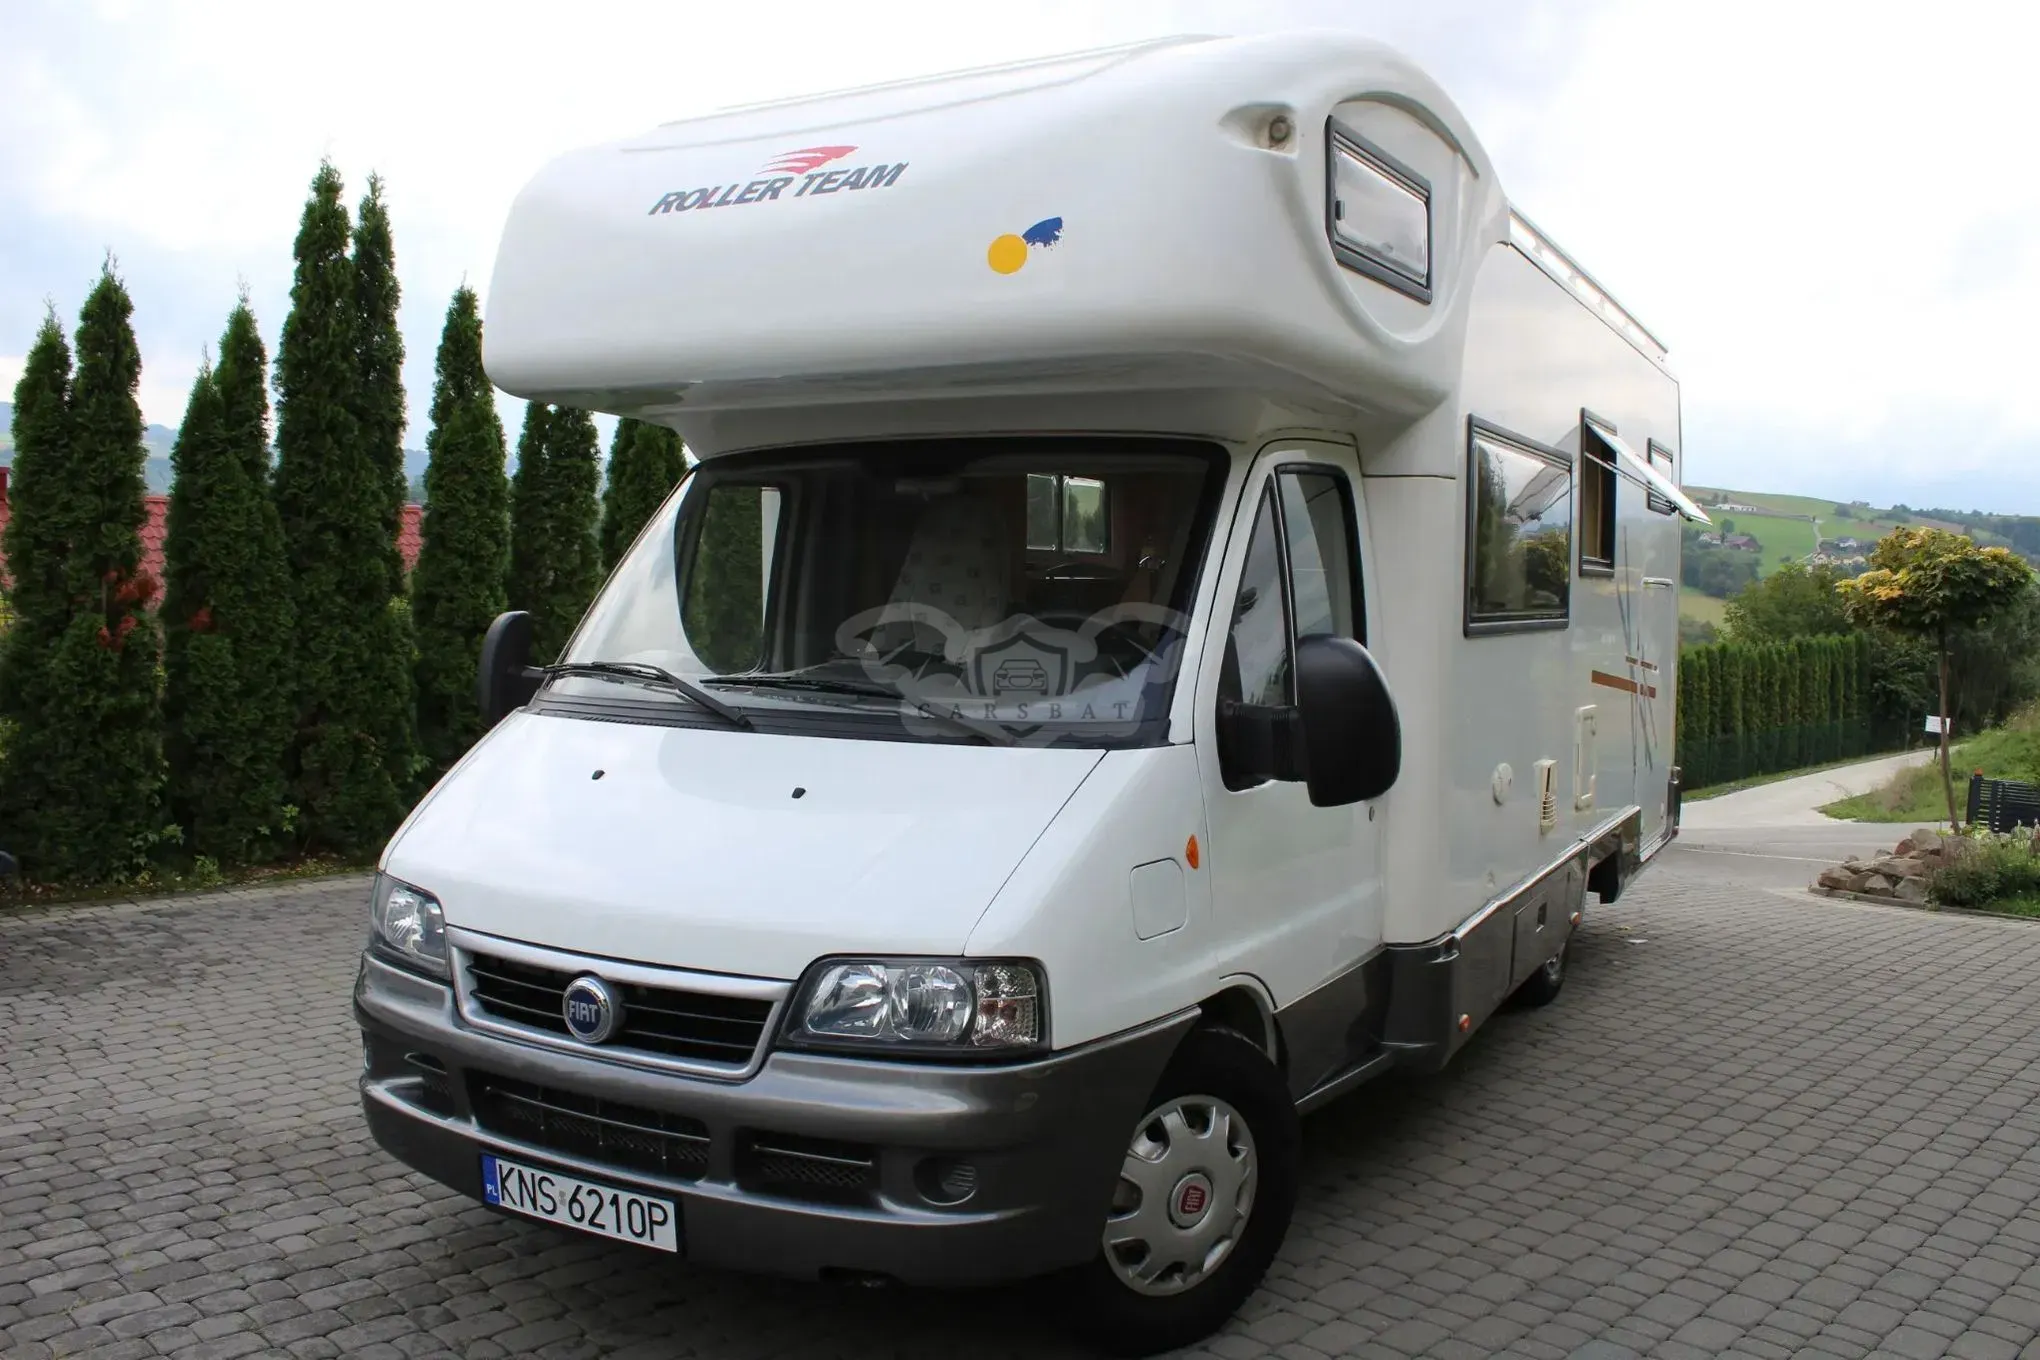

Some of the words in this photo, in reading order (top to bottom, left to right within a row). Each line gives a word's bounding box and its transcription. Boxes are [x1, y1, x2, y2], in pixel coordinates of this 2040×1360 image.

[648, 176, 794, 215] ROLLER
[794, 161, 909, 198] TEAM
[568, 1000, 598, 1023] FIAT
[486, 1183, 498, 1197] PL
[498, 1163, 558, 1216] KNS
[568, 1184, 669, 1242] 6210P
